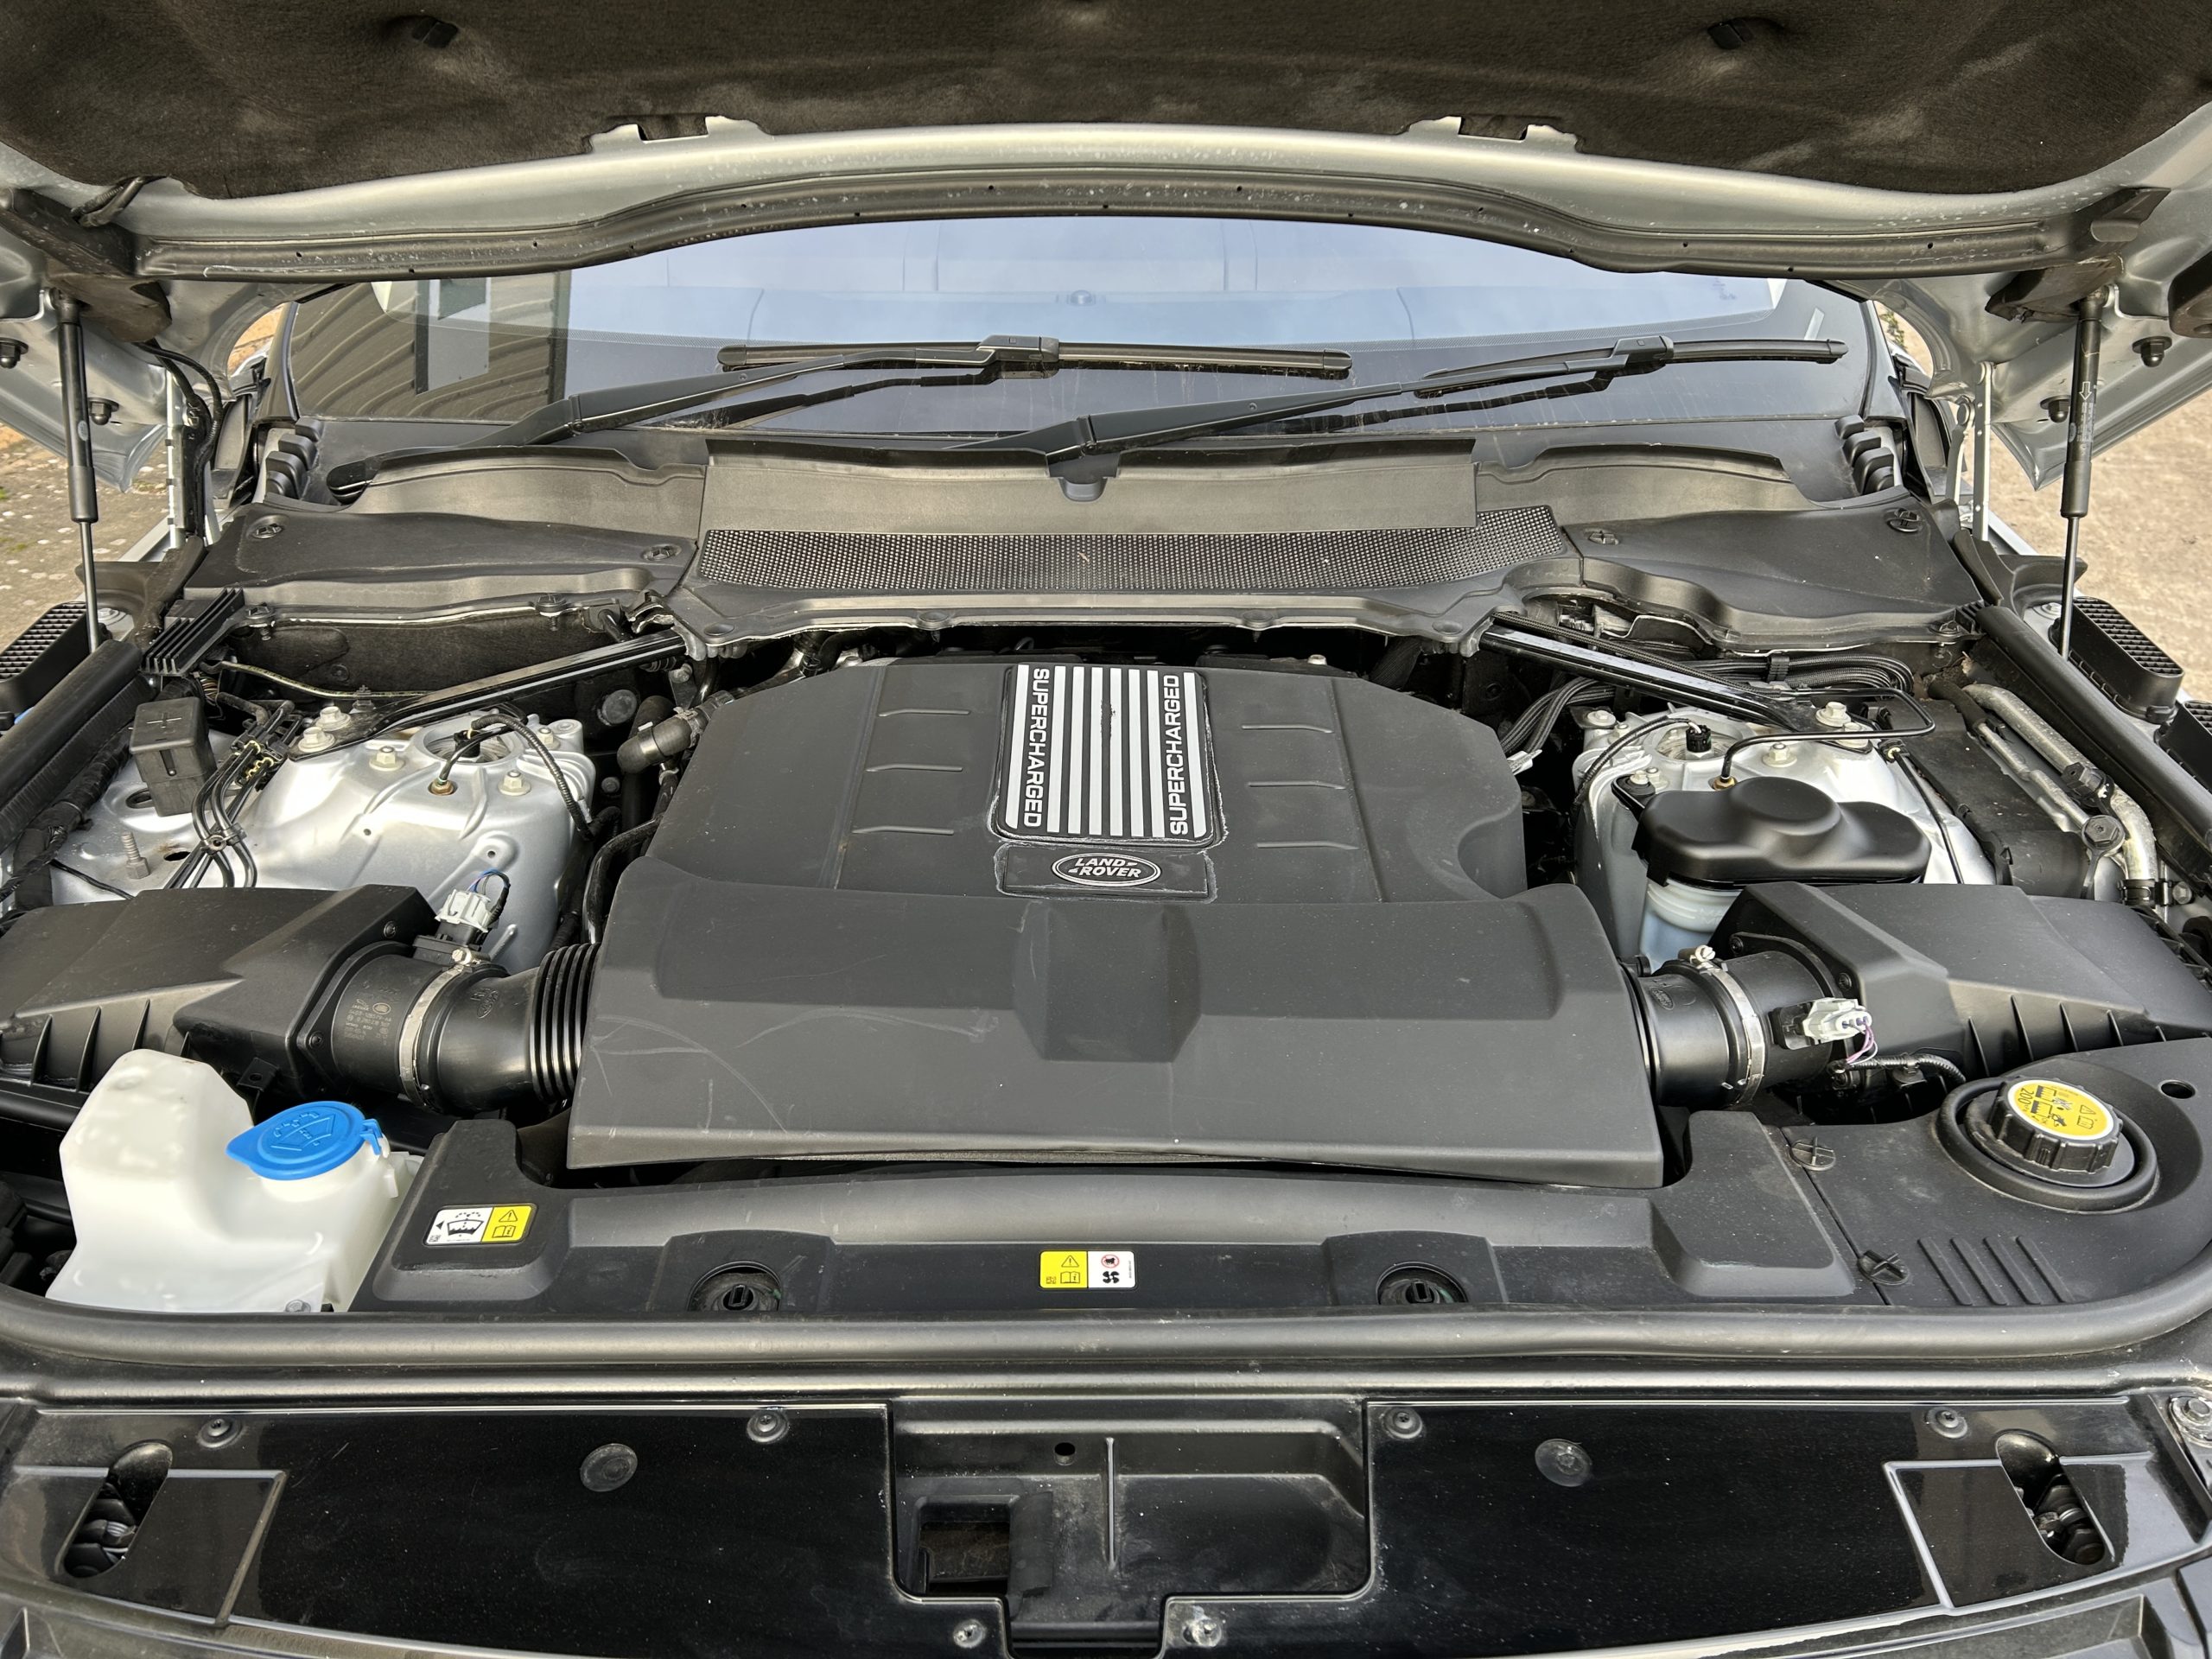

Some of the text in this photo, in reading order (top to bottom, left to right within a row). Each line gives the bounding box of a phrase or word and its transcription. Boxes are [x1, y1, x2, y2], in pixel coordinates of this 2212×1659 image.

[1023, 668, 1050, 828] SUPERCHARGED
[1163, 675, 1188, 836] SUPERCHARGED
[1075, 858, 1125, 867] LAND
[1078, 867, 1141, 878] ROVER
[2018, 1088, 2034, 1105] 200
